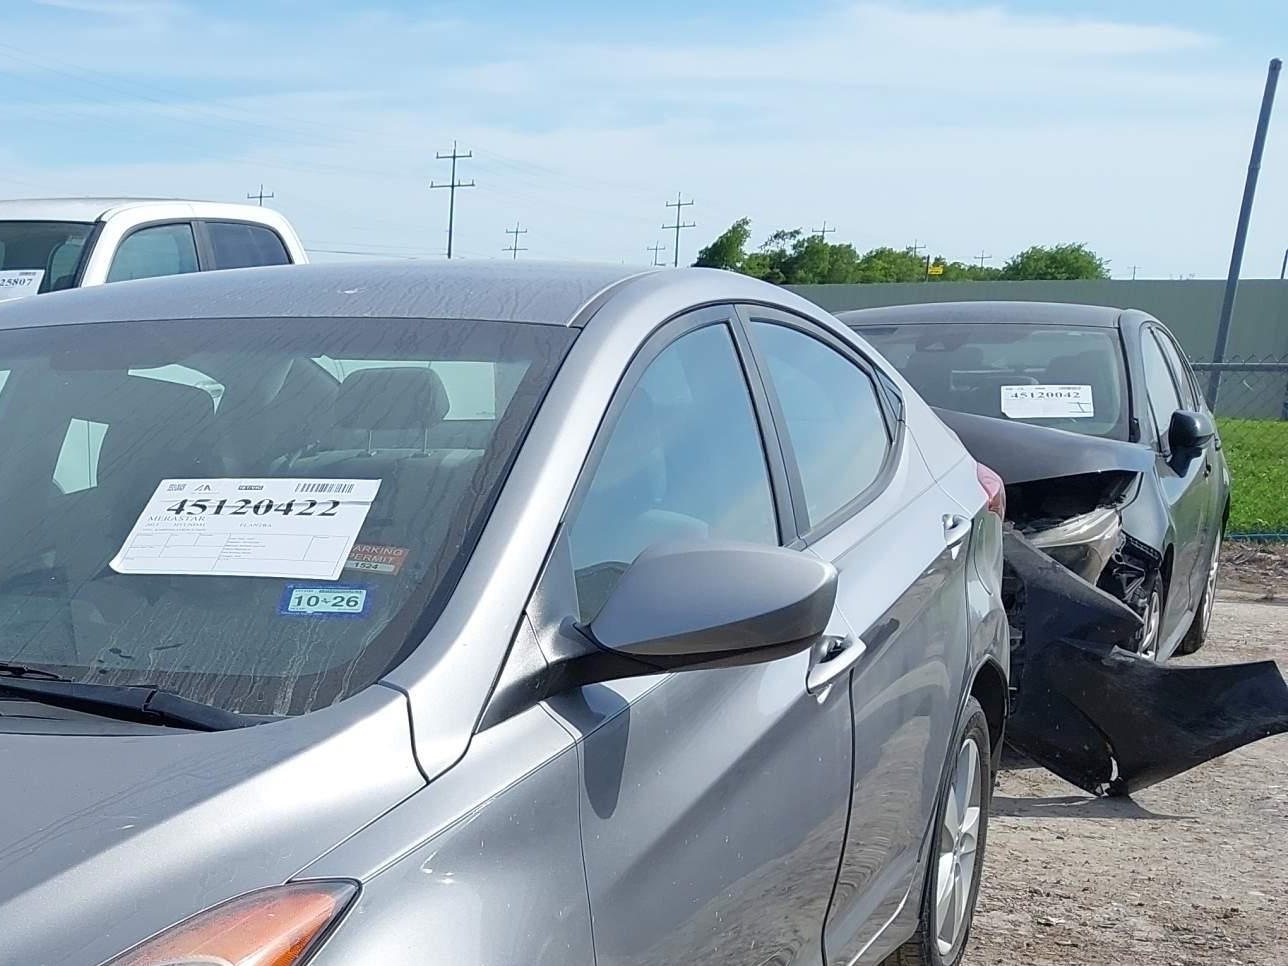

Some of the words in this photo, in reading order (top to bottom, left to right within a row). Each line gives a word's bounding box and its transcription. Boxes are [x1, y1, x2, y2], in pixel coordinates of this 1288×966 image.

[1010, 391, 1081, 399] 45120042
[166, 498, 340, 517] 45120422
[352, 544, 403, 556] ARKING
[353, 562, 379, 570] 1524
